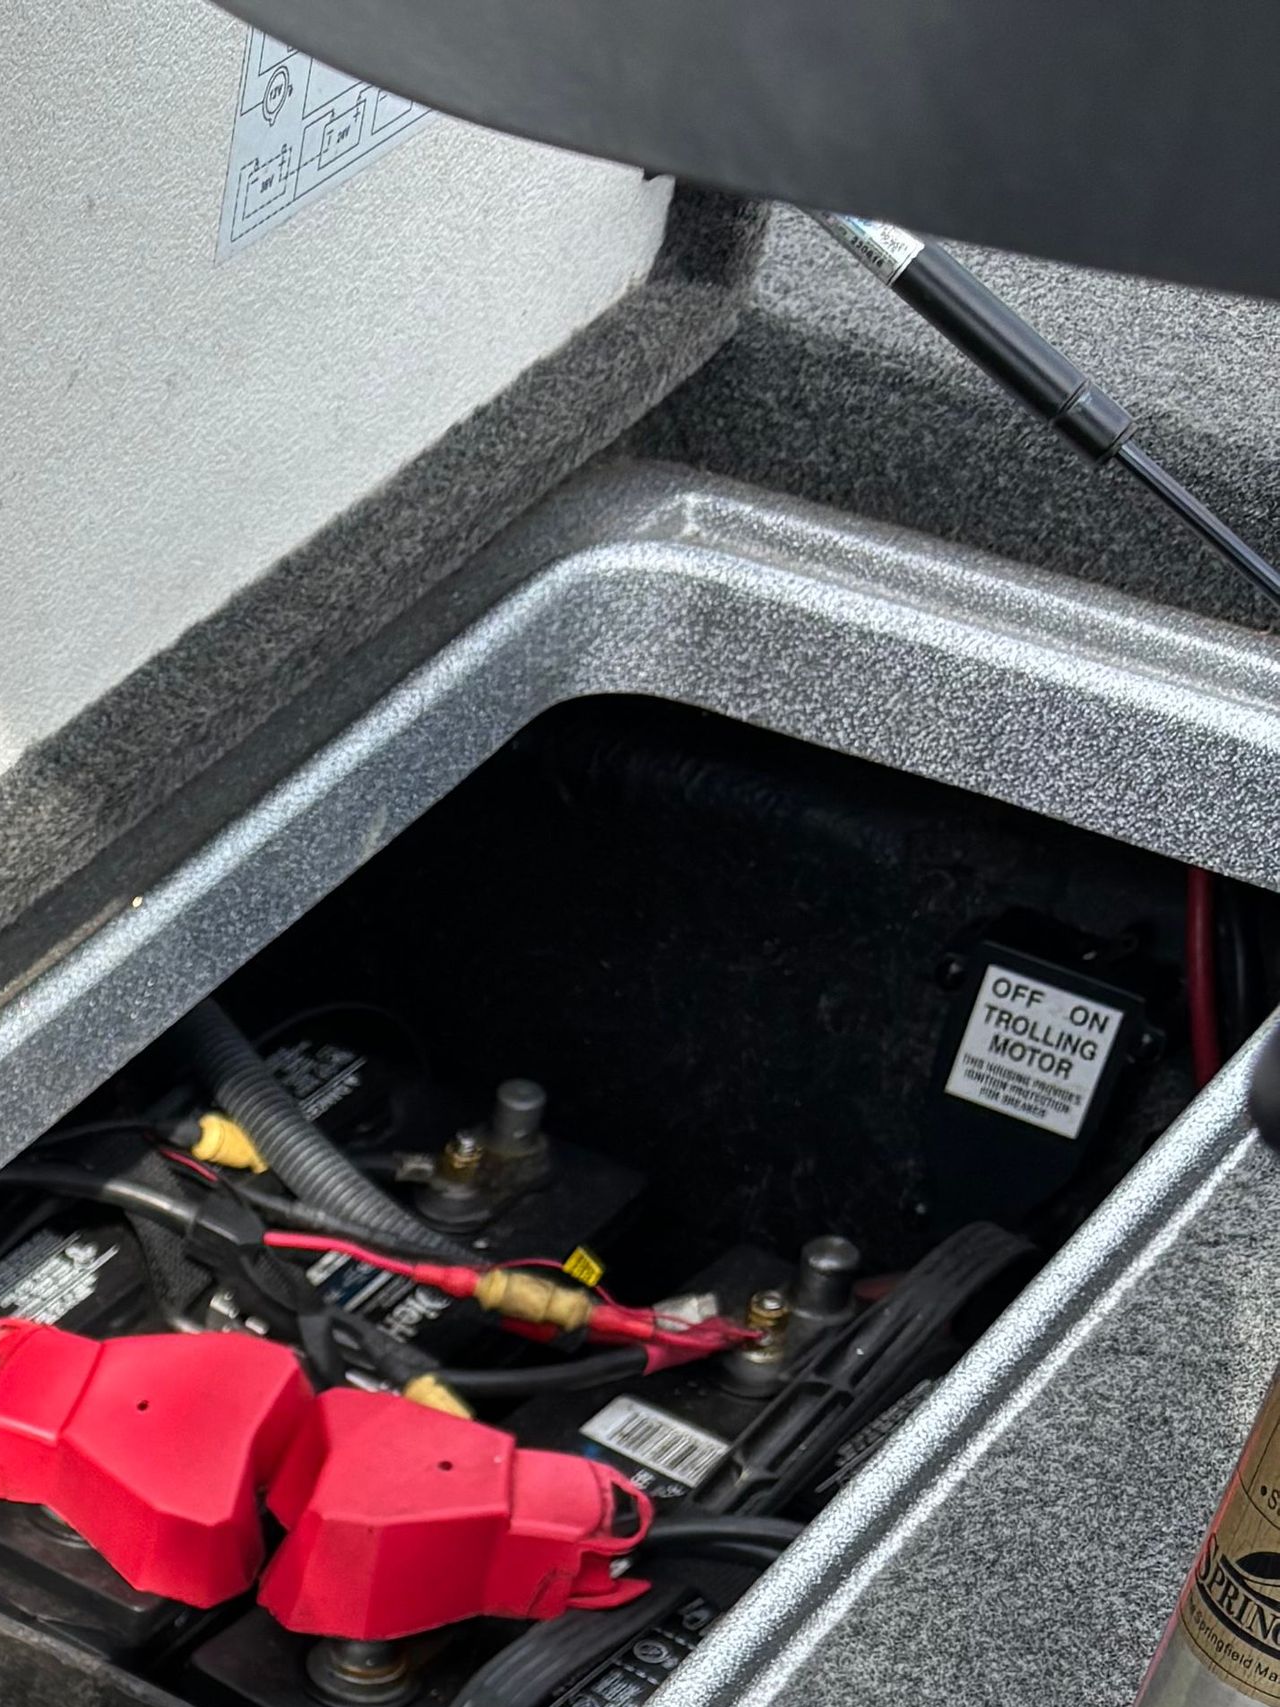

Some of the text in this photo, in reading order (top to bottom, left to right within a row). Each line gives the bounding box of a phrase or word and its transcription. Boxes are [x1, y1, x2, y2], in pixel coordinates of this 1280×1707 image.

[985, 1004, 1097, 1060] TROLLING
[991, 977, 1109, 1033] OFF ON
[989, 1034, 1072, 1078] MOTOR
[1193, 1611, 1254, 1670] Springfield
